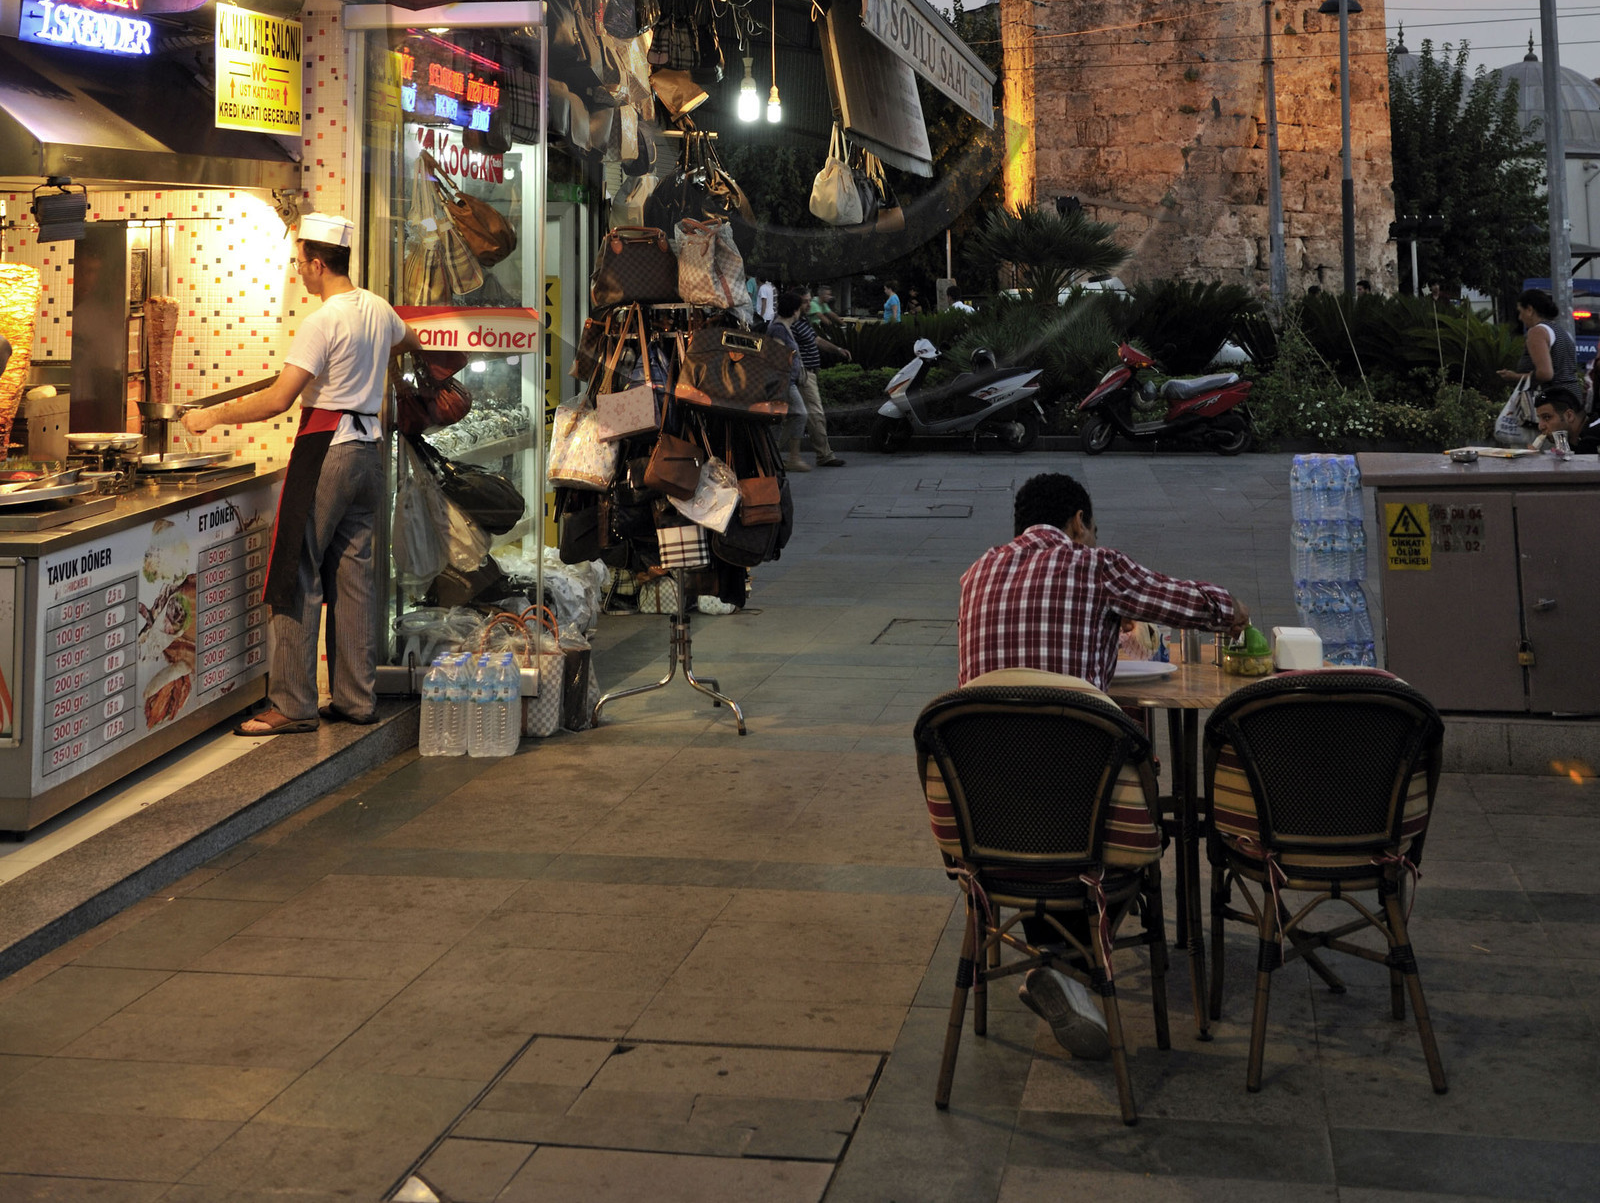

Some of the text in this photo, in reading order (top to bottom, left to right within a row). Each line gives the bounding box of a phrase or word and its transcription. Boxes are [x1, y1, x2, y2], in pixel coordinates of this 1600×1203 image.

[271, 21, 301, 63] SALONU
[251, 61, 268, 83] WC
[940, 45, 969, 101] SAAT
[241, 104, 262, 122] KARTI
[467, 325, 537, 349] döner
[198, 506, 235, 533] ET DÖNER
[47, 547, 112, 586] TAVUK DÖNER
[209, 550, 217, 564] 50
[205, 570, 217, 585] 100
[205, 590, 217, 605] 150
[61, 605, 73, 621] 50
[204, 611, 217, 626] 200
[56, 628, 73, 646] 100
[204, 631, 217, 646] 250
[55, 651, 72, 670] 150
[203, 651, 217, 667] 300
[54, 674, 72, 694] 200
[203, 671, 217, 687] 350
[54, 698, 72, 718] 250
[53, 722, 71, 742] 300
[53, 745, 71, 765] 350
